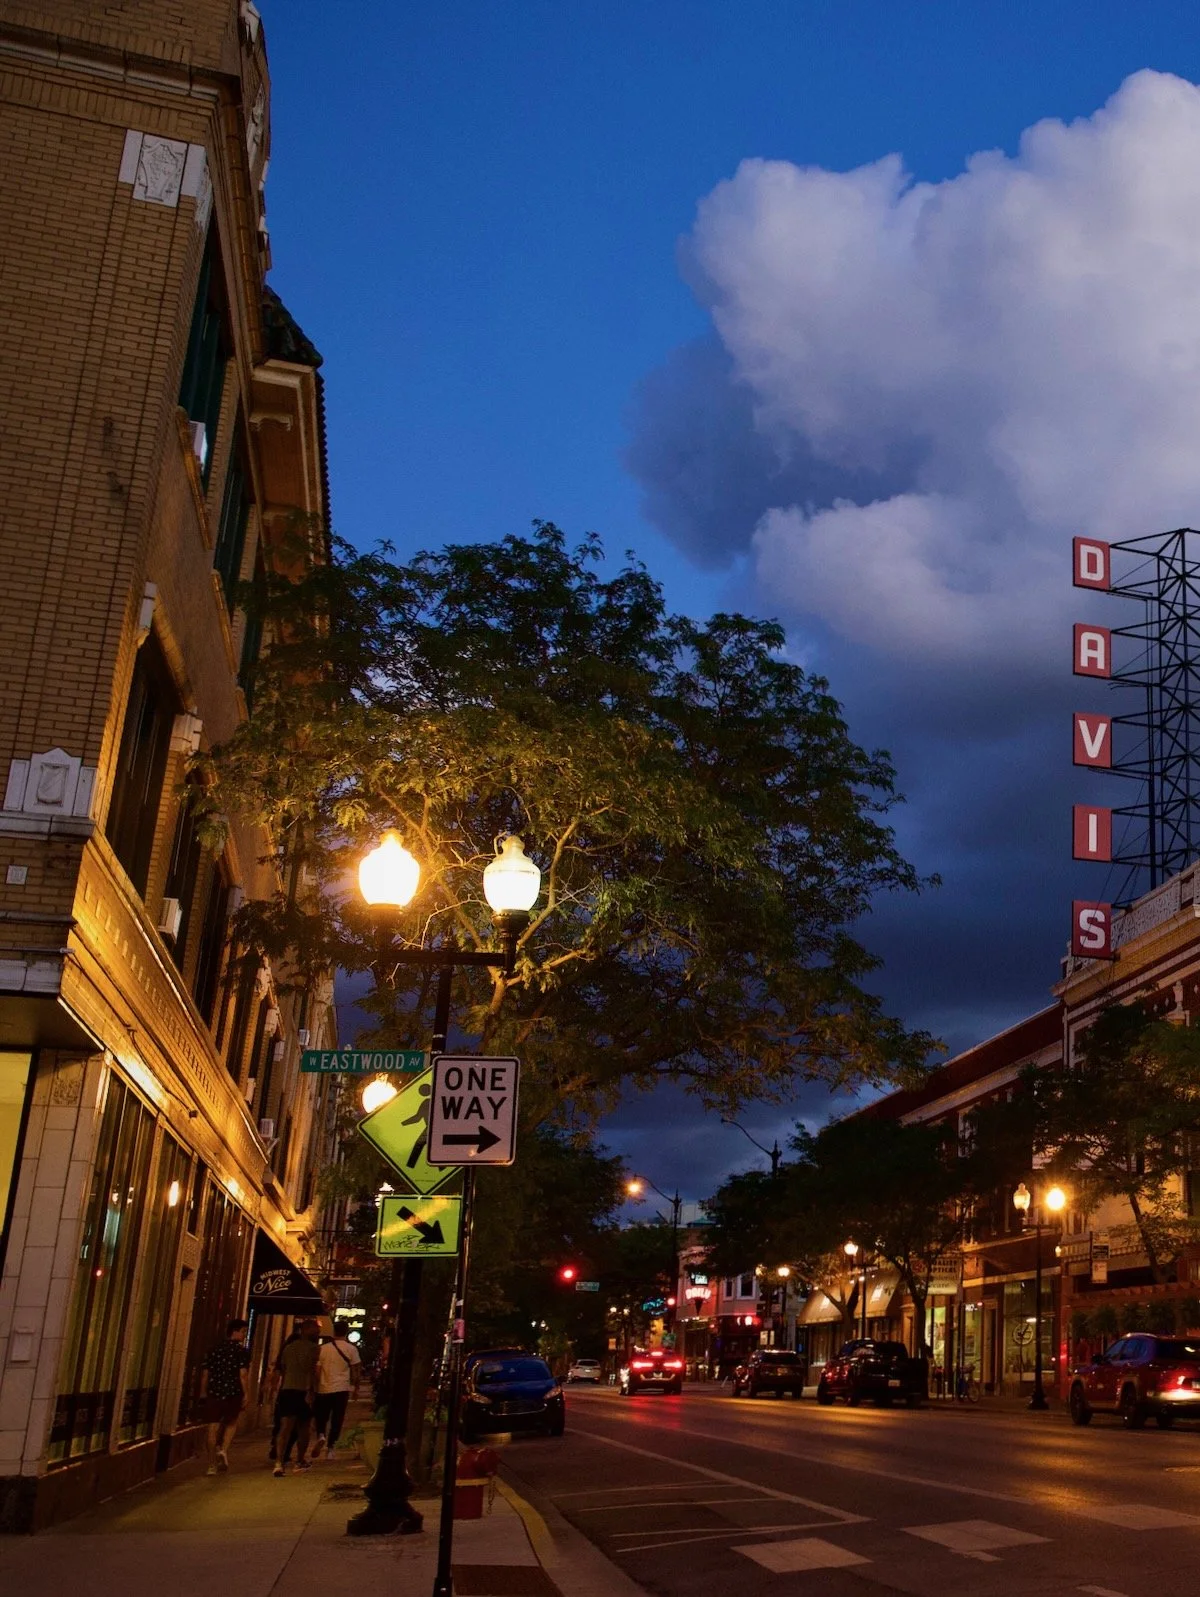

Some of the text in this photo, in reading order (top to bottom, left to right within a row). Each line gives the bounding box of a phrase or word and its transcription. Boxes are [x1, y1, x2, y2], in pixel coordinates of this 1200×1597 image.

[1079, 543, 1107, 949] DAVIS
[309, 1053, 420, 1070] W EASTWOOD AV
[444, 1066, 507, 1092] ONE
[440, 1096, 508, 1121] WAY
[253, 1276, 292, 1295] Nice
[260, 1269, 292, 1281] MIDWEST
